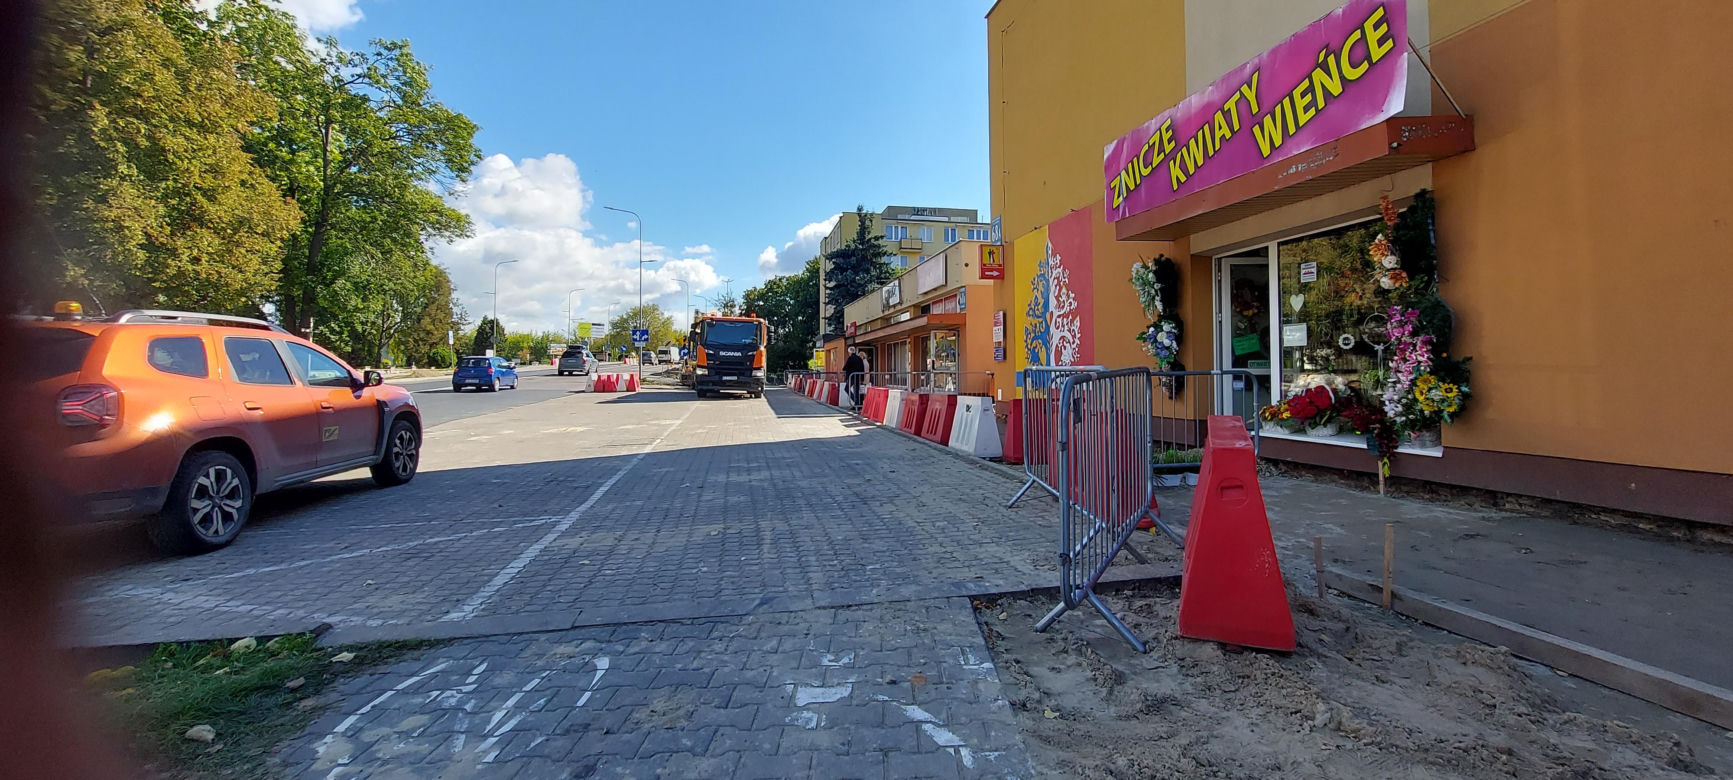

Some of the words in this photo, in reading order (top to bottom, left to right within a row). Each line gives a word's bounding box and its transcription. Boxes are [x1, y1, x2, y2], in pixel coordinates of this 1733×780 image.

[1169, 69, 1261, 191] KWIATY
[1253, 5, 1395, 159] WIEŃCE
[1109, 117, 1176, 209] ZNICZE
